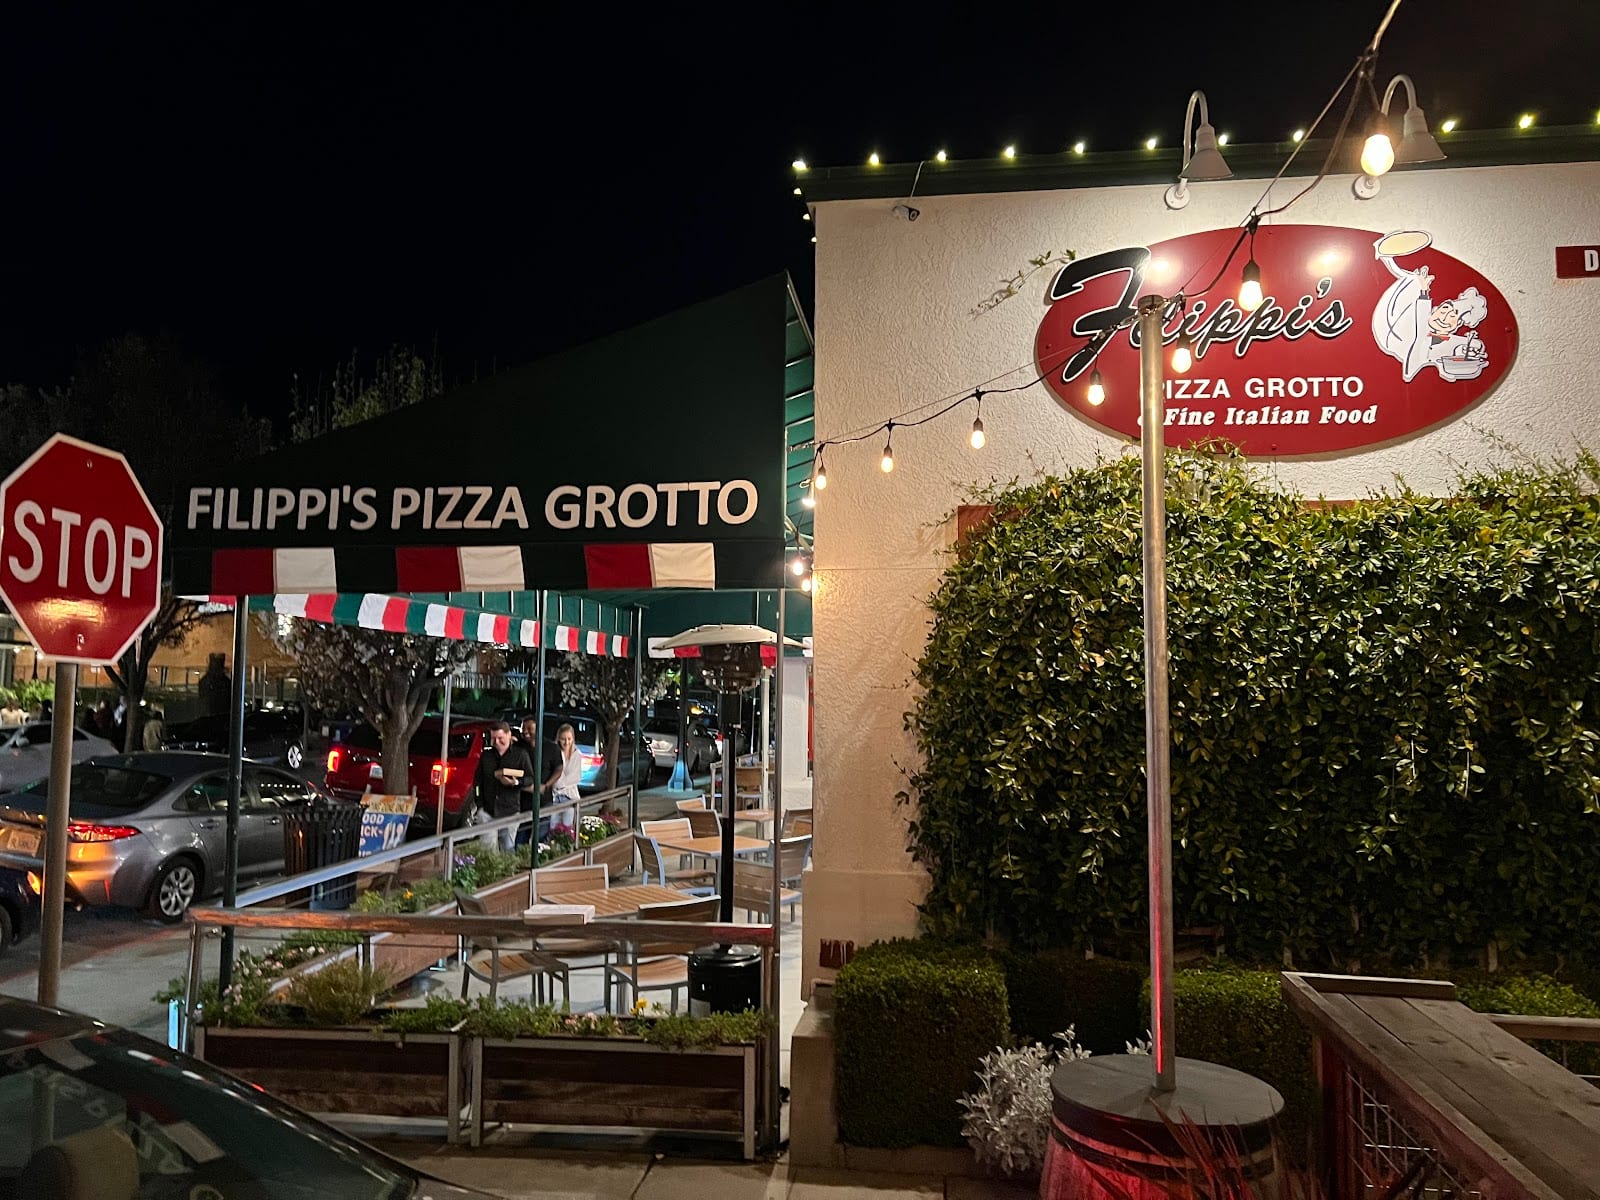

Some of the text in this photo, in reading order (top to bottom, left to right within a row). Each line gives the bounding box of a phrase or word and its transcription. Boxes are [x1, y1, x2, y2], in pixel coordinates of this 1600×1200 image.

[1050, 246, 1352, 383] Flippi's
[1162, 376, 1364, 399] IZZA GROTTO
[1163, 407, 1216, 426] Fine
[1224, 406, 1310, 425] Italian
[1318, 405, 1378, 425] Food
[187, 479, 759, 531] FILIPPI'S PIZZA GROTTO
[8, 499, 153, 599] STOP
[362, 813, 385, 825] OOD
[360, 824, 384, 838] ICK-
